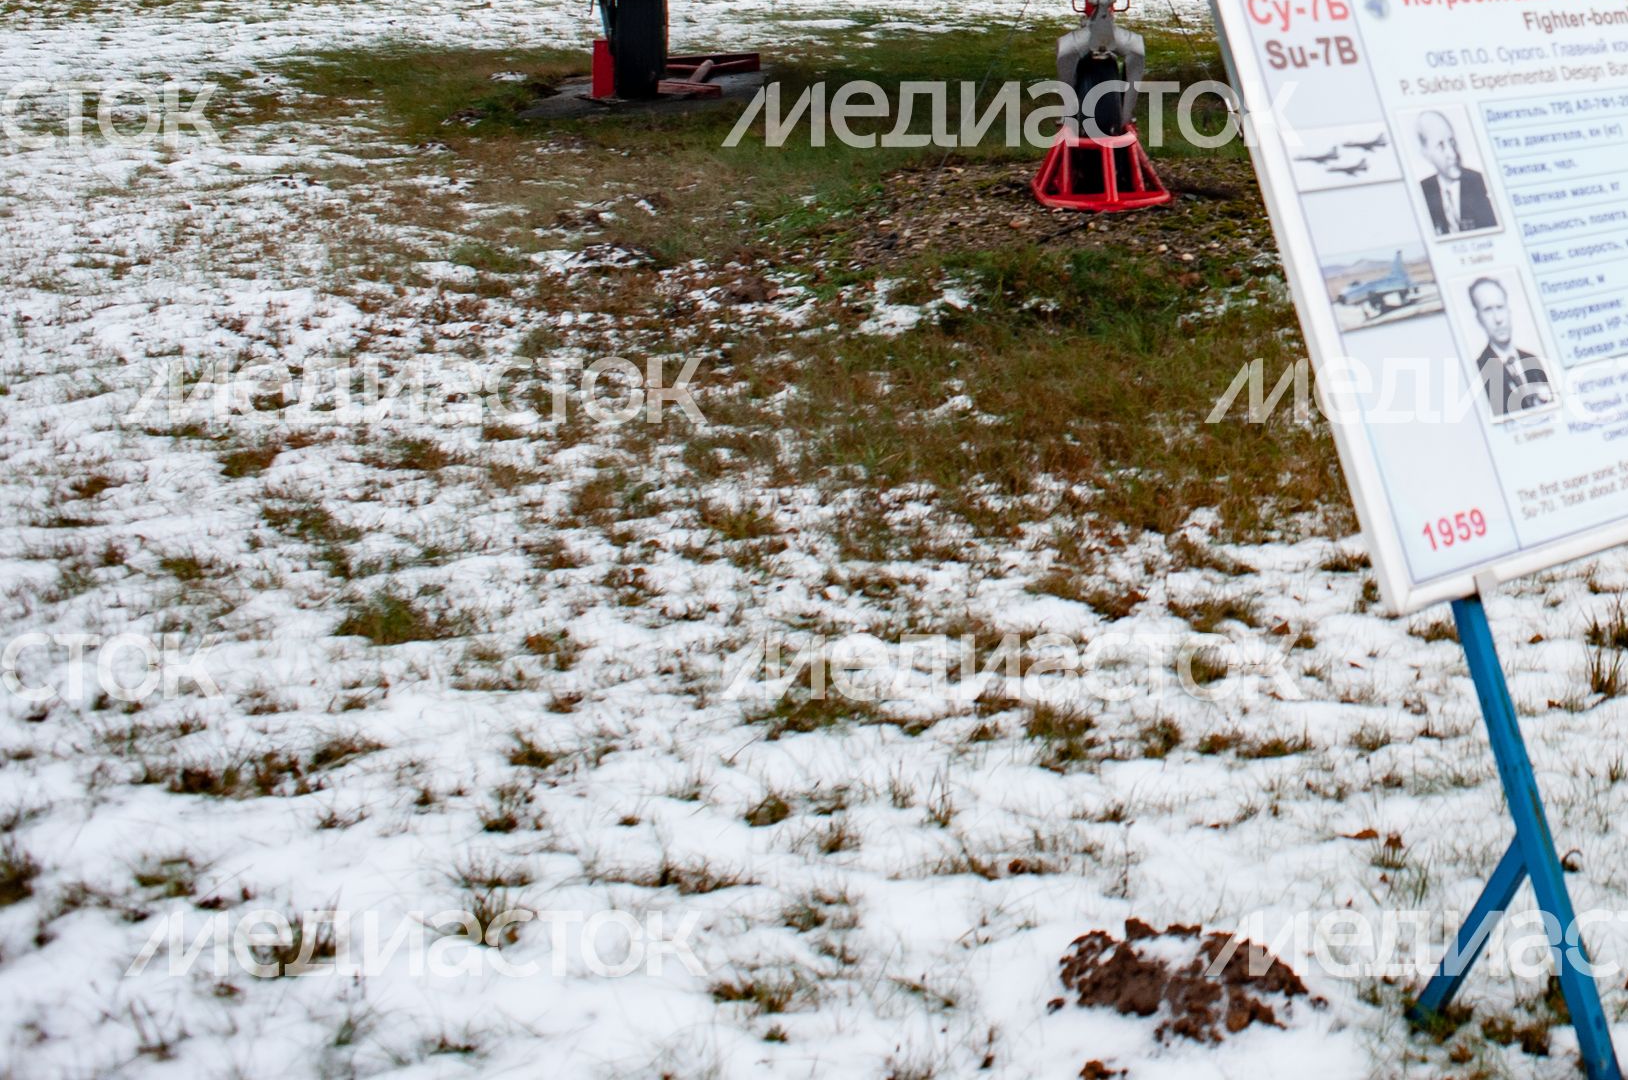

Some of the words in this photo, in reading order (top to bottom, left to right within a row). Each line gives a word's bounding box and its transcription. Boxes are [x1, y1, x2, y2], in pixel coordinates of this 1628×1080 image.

[1264, 35, 1358, 70] Su-7B
[1424, 48, 1458, 68] ОКБ
[1550, 37, 1609, 57] Главный
[1416, 74, 1467, 95] Sukhoi
[1468, 66, 1558, 91] Experimental
[1559, 64, 1605, 82] Design
[1422, 507, 1486, 550] 1959
